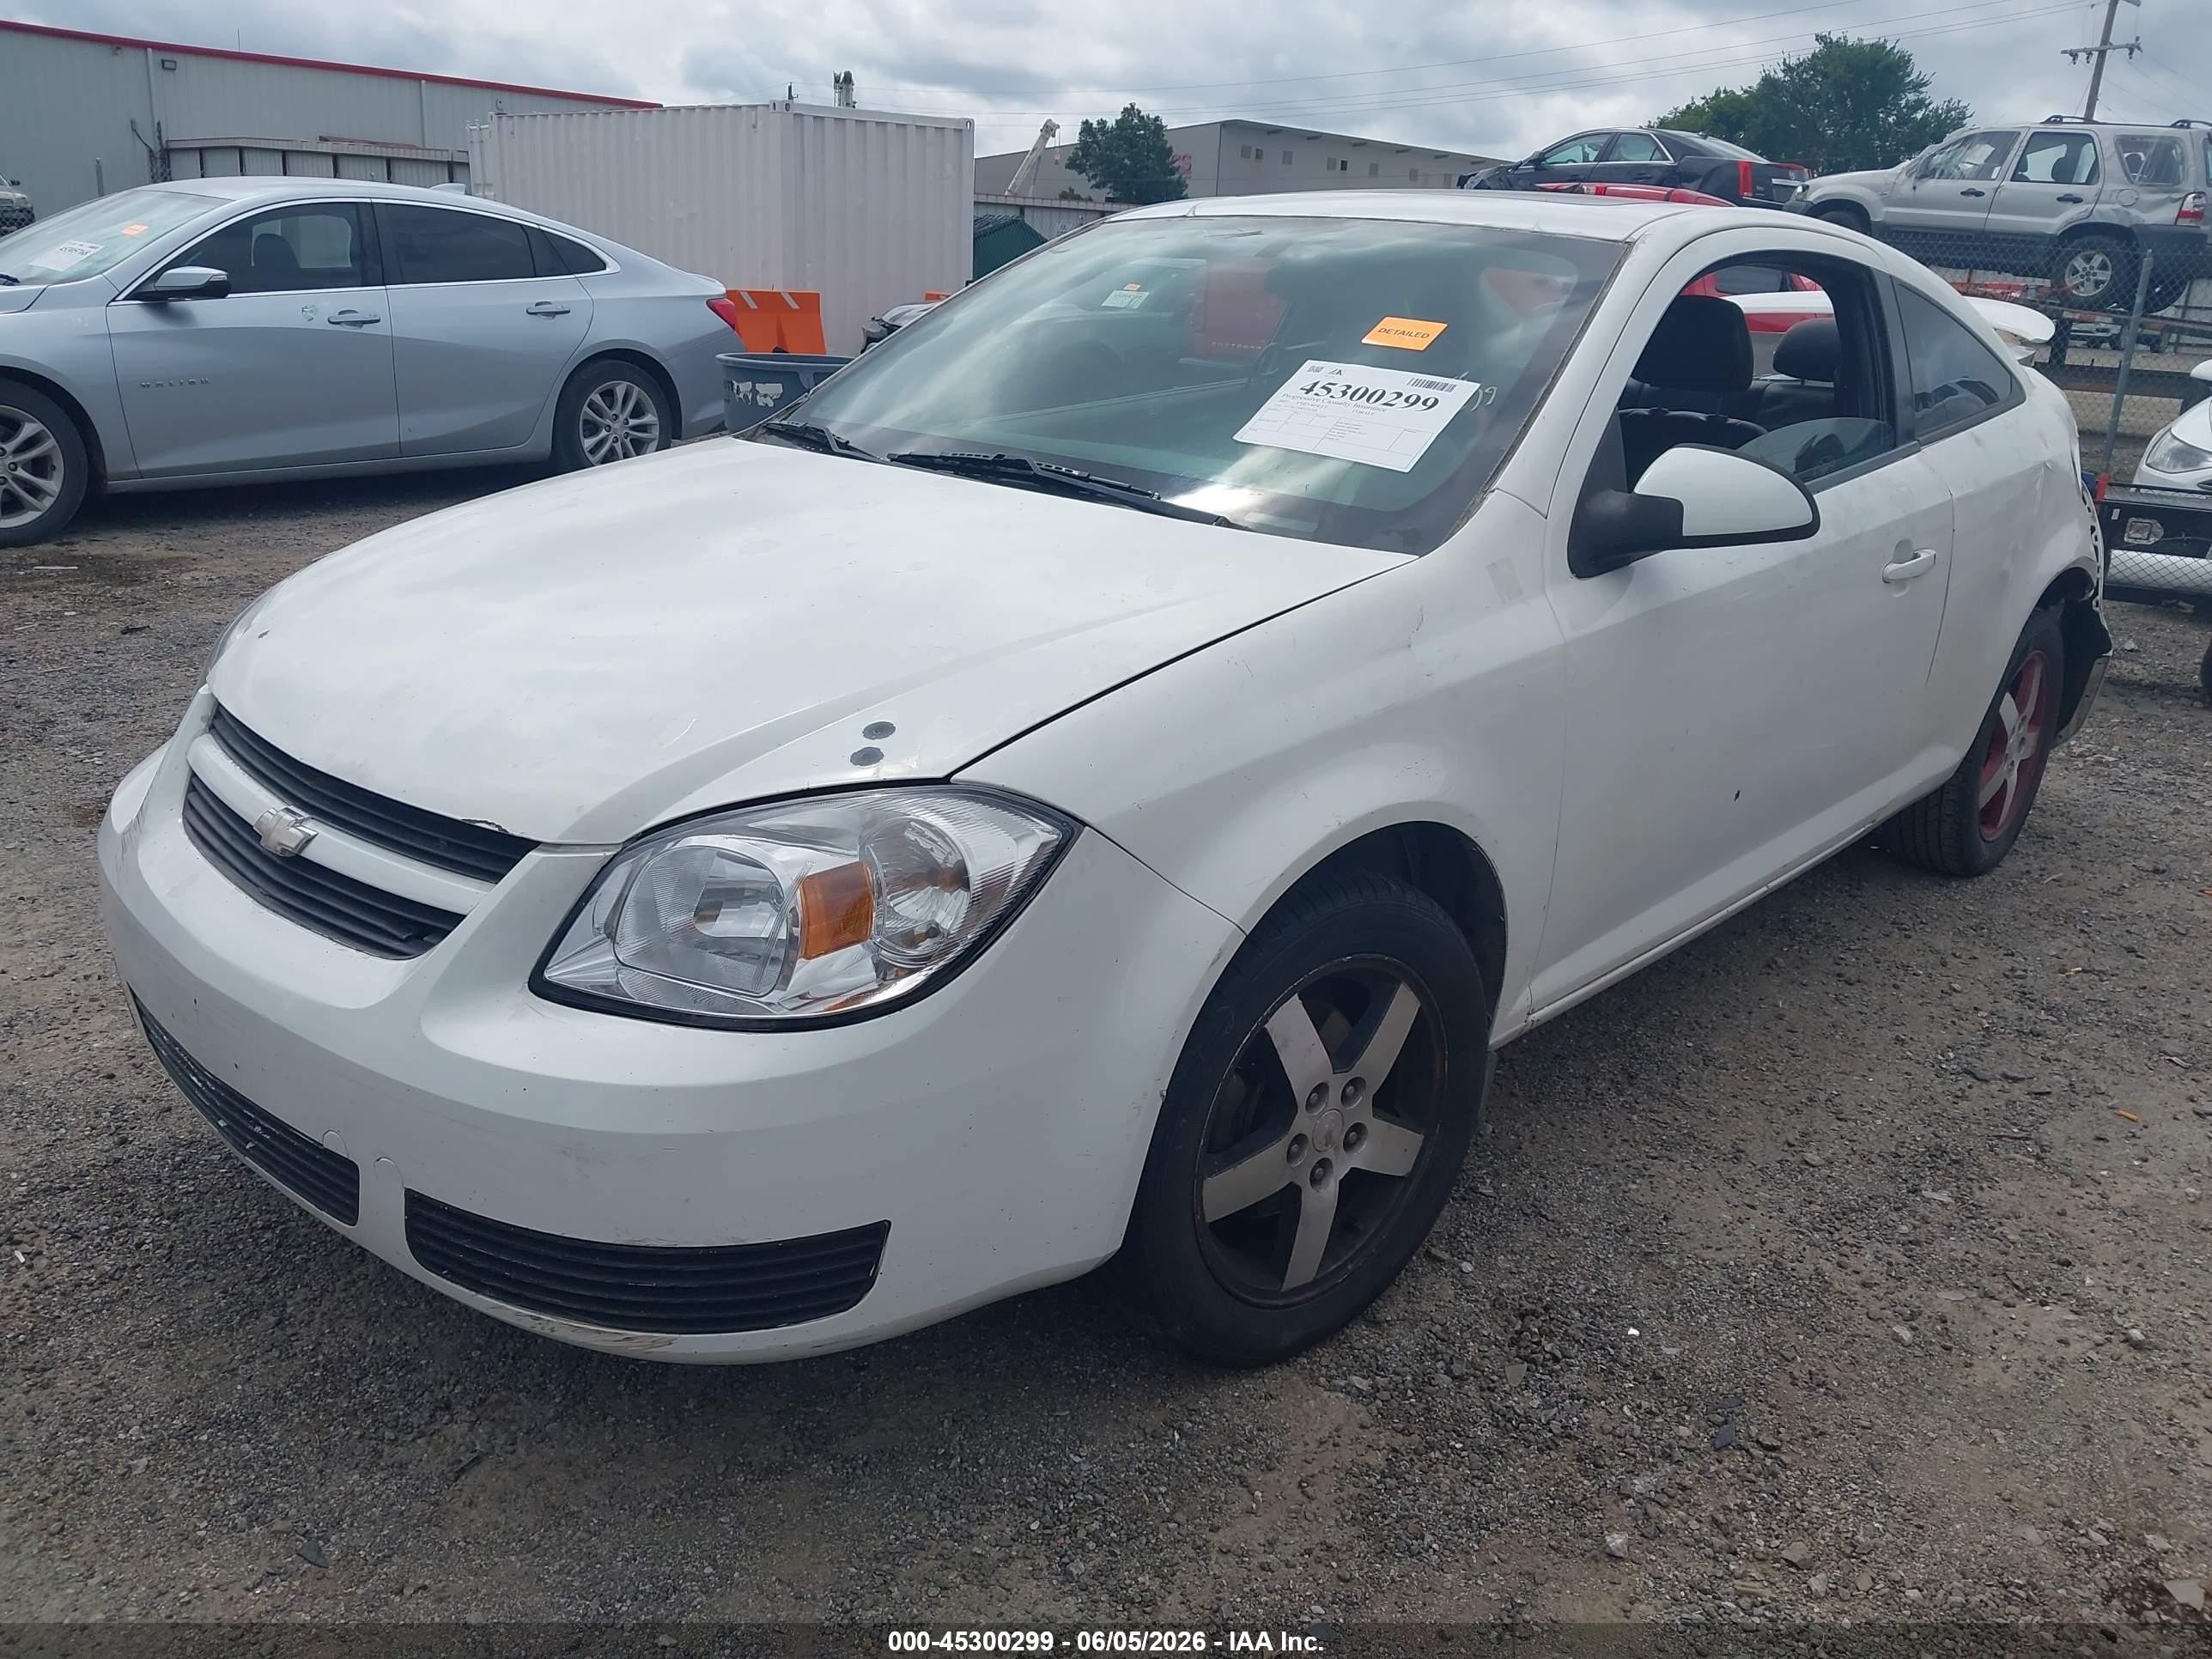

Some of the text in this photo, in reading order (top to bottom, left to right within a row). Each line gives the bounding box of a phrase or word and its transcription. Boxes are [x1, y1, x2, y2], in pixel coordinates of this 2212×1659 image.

[1377, 327, 1430, 339] DETAILED
[1281, 392, 1321, 403] Progressive
[1322, 397, 1351, 408] Casualty
[1352, 401, 1388, 412] Insurance
[1299, 380, 1440, 412] 45300299
